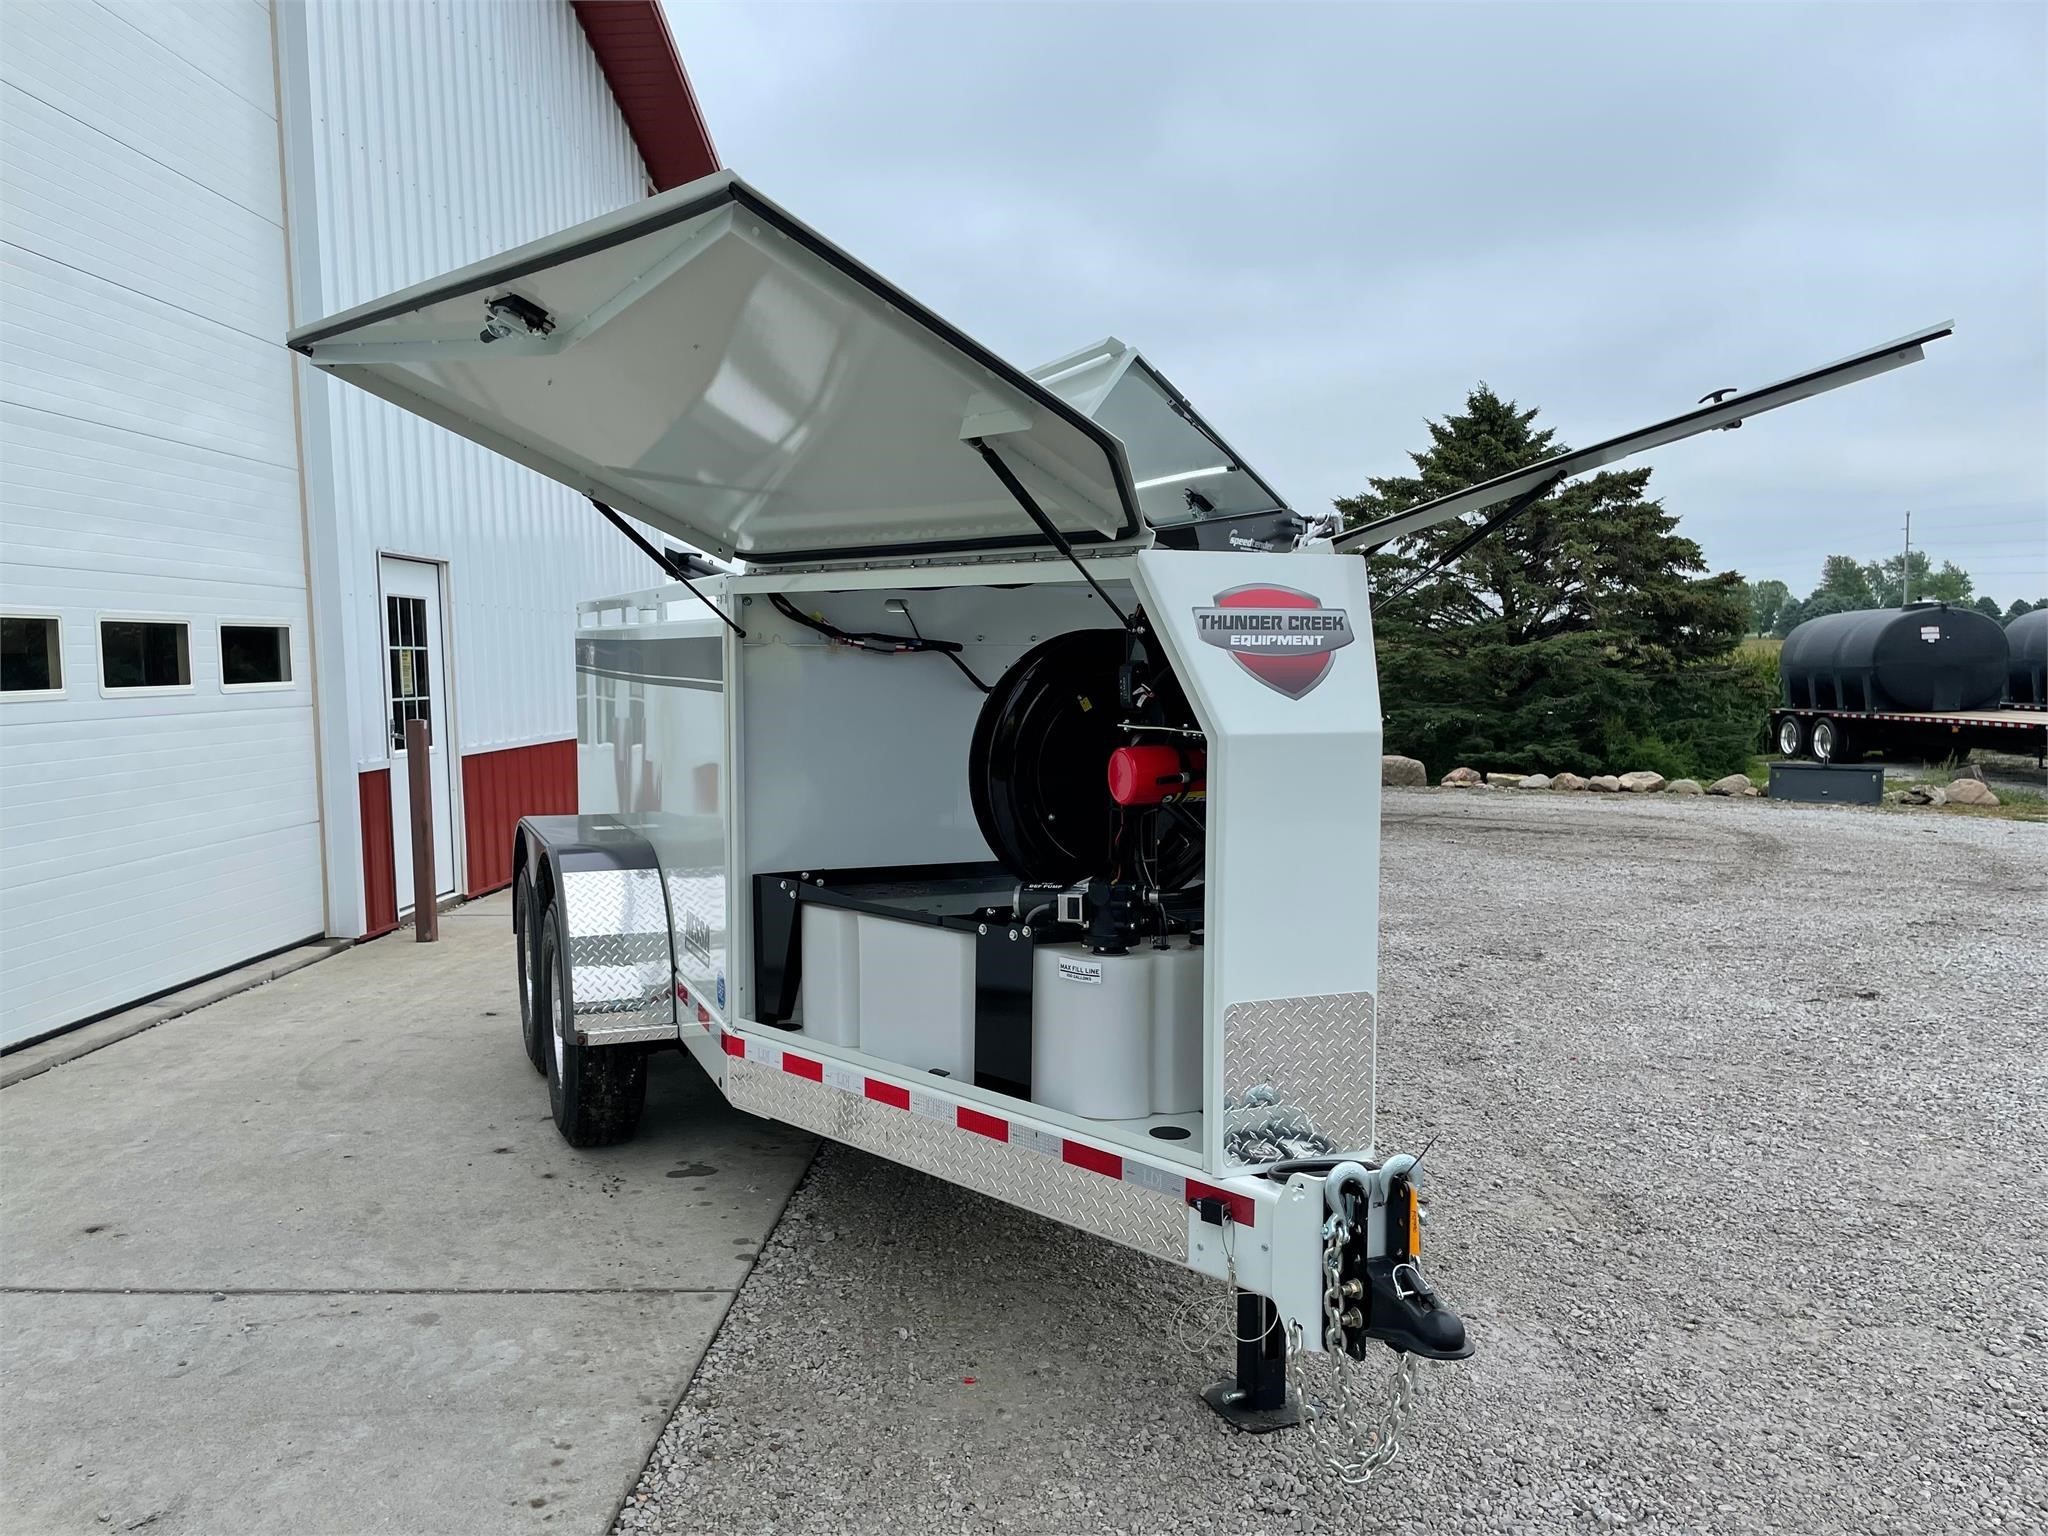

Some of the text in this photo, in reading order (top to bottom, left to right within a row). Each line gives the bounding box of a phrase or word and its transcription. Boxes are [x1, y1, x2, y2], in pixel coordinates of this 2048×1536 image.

[1199, 614, 1344, 631] THUNDER CREEK
[1230, 634, 1324, 646] EQUIPMENT
[1060, 963, 1072, 971] MAX
